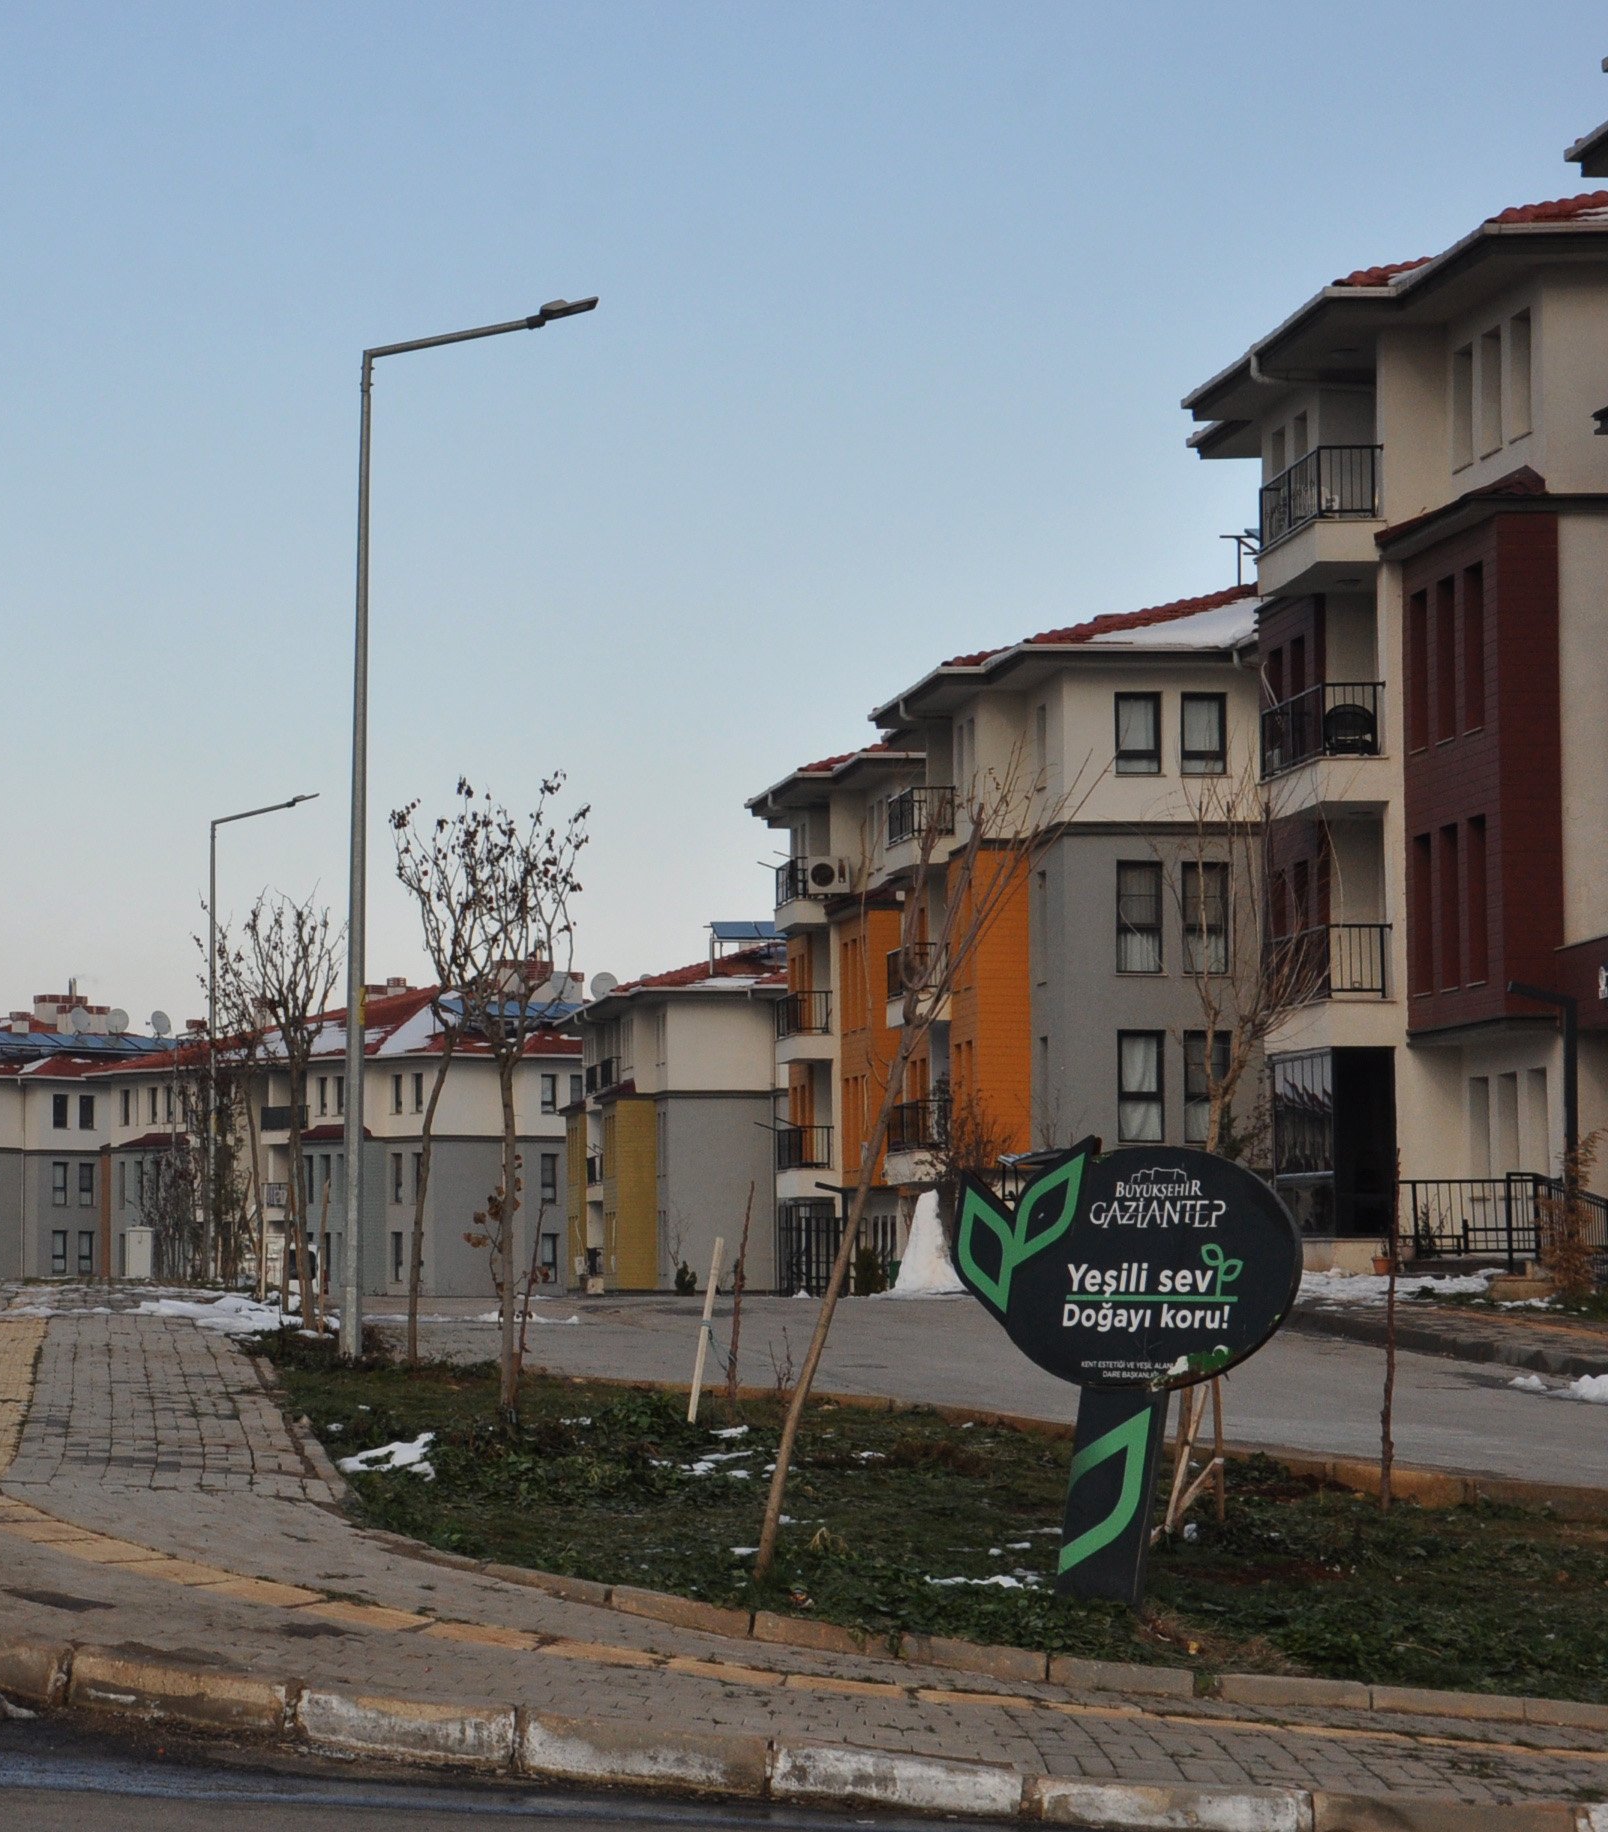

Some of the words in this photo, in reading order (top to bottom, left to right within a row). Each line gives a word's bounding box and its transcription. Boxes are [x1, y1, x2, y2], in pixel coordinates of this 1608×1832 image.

[1115, 1179, 1203, 1200] BÜYÜKŞEHİR
[1089, 1197, 1227, 1228] GAZİANTEP
[1067, 1262, 1149, 1297] Yeşili
[1158, 1269, 1214, 1293] sev
[1062, 1302, 1152, 1333] Doğayı
[1160, 1303, 1230, 1330] koru!
[1081, 1360, 1097, 1368] KENT
[1126, 1361, 1135, 1369] VE
